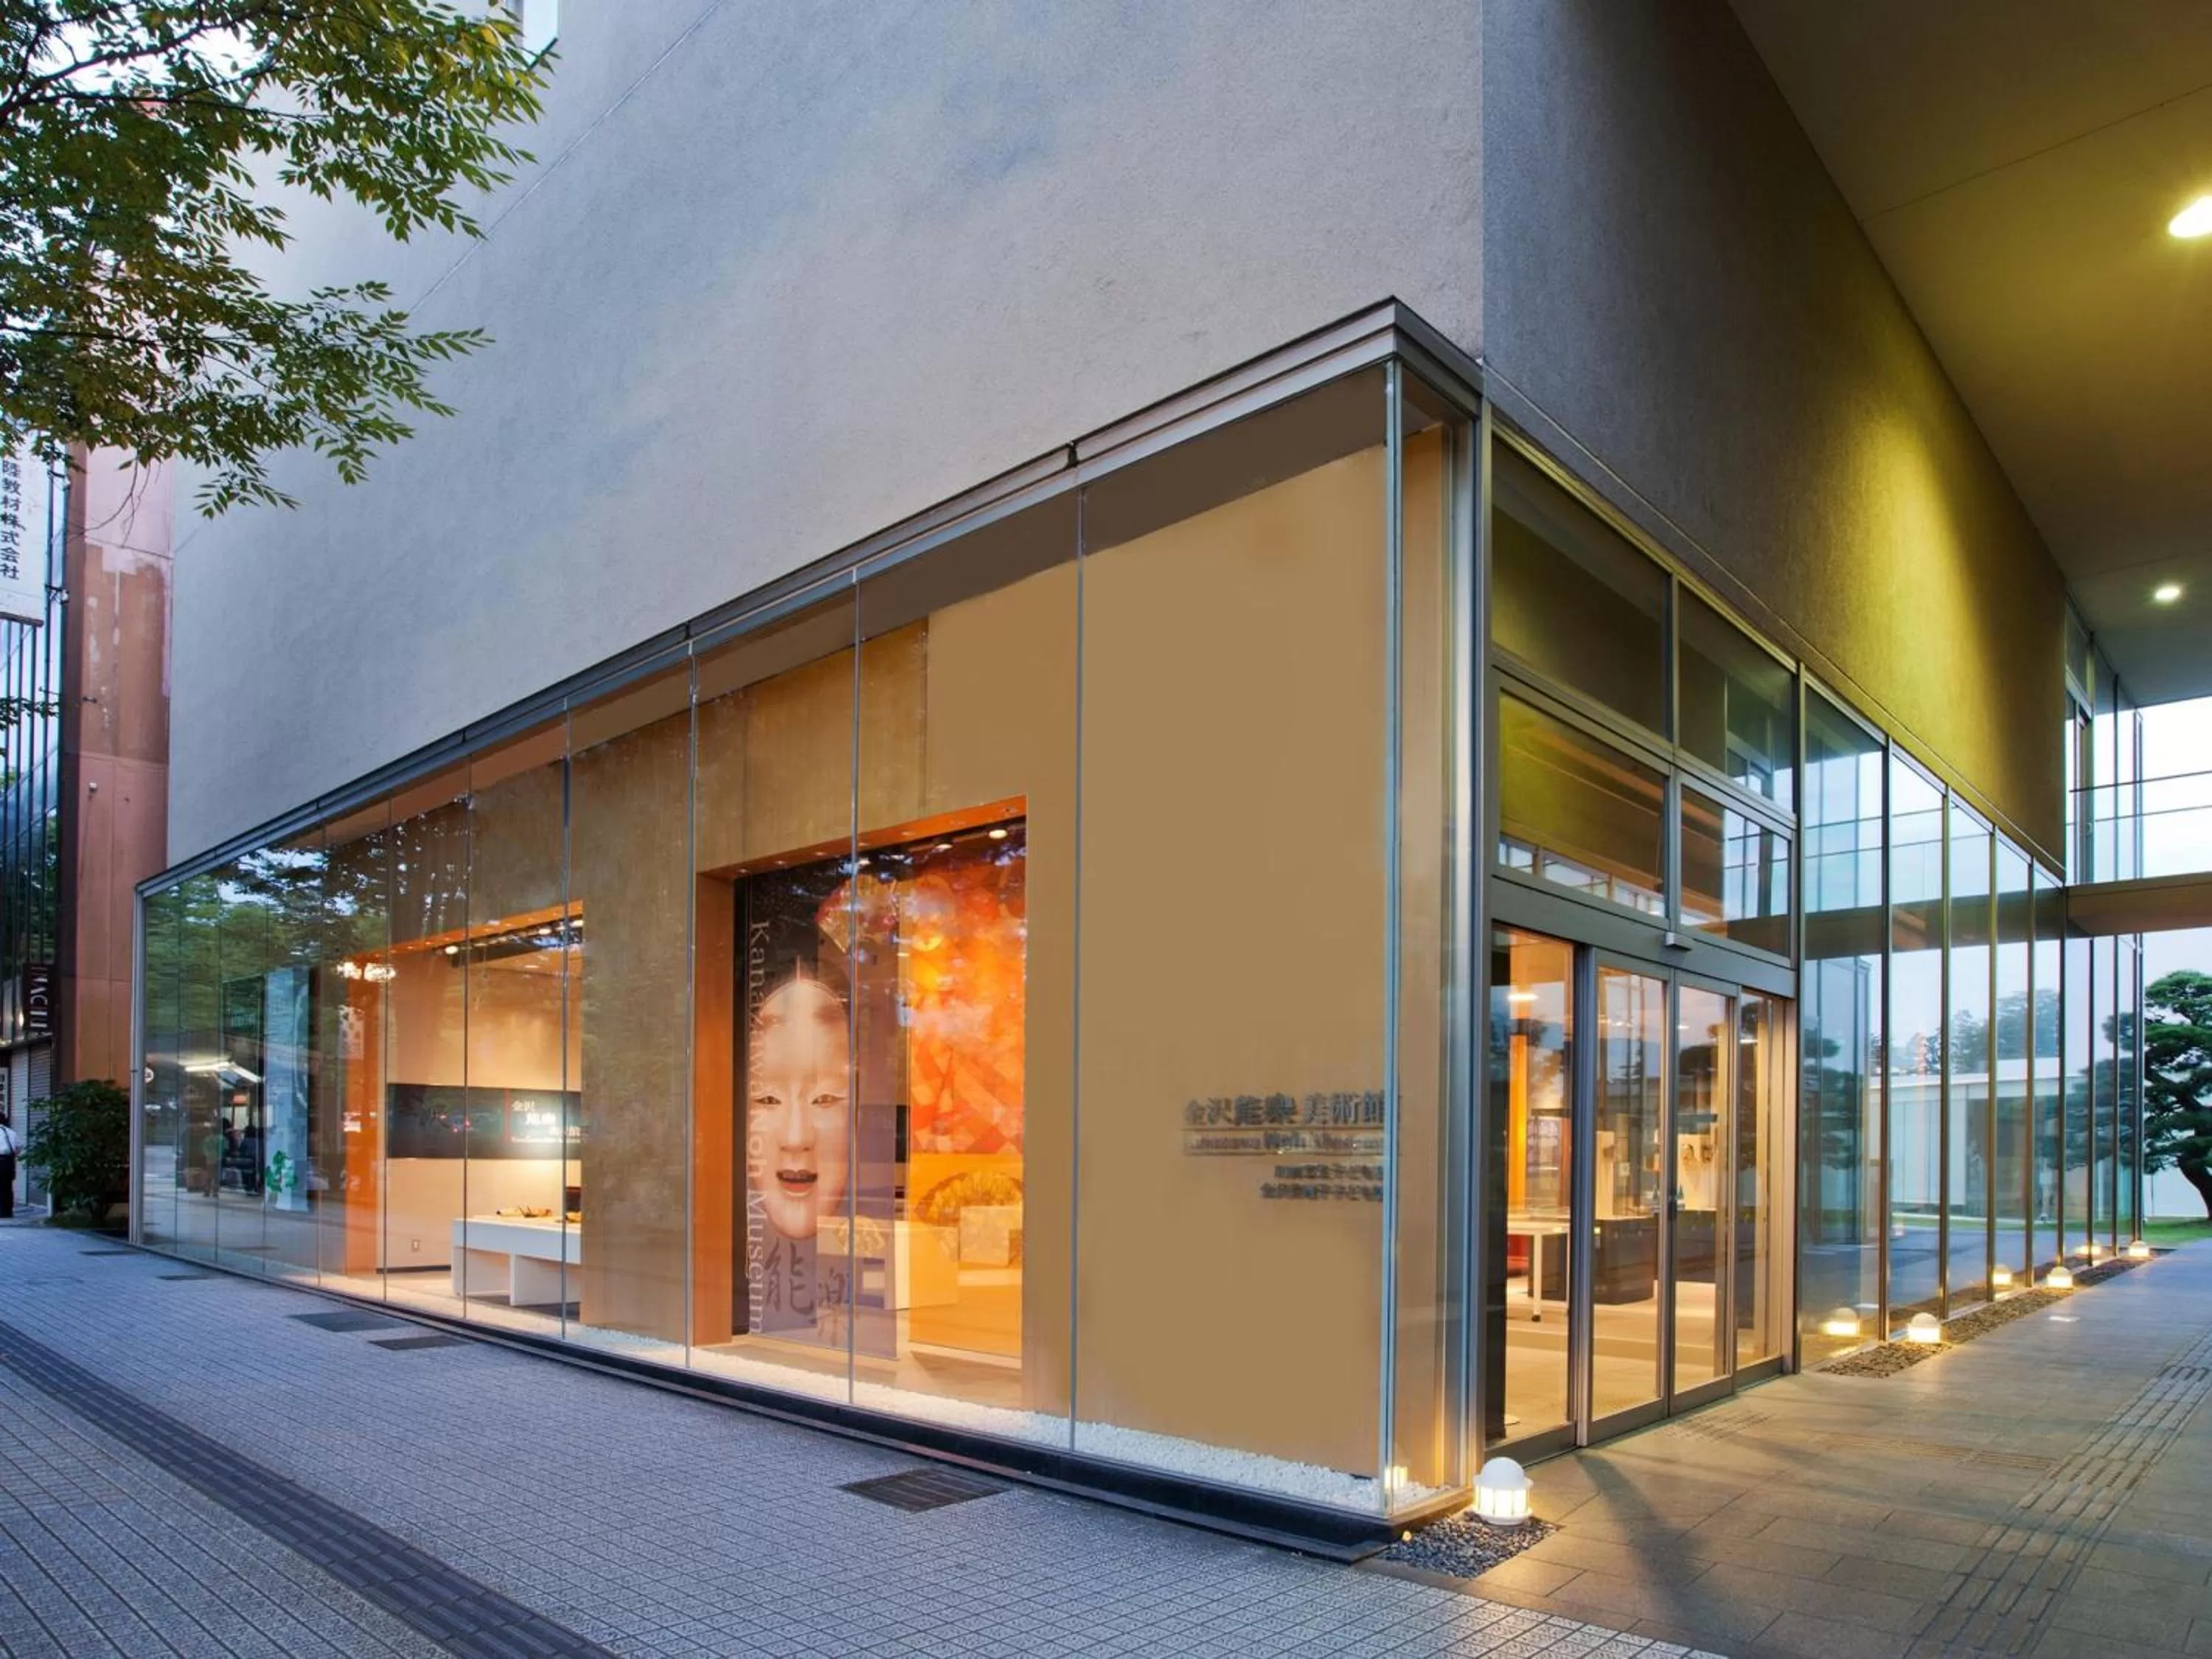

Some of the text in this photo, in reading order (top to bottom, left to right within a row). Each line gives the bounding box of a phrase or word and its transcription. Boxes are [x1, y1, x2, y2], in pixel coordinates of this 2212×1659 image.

[747, 921, 770, 1334] Kanazawa Noh Museum
